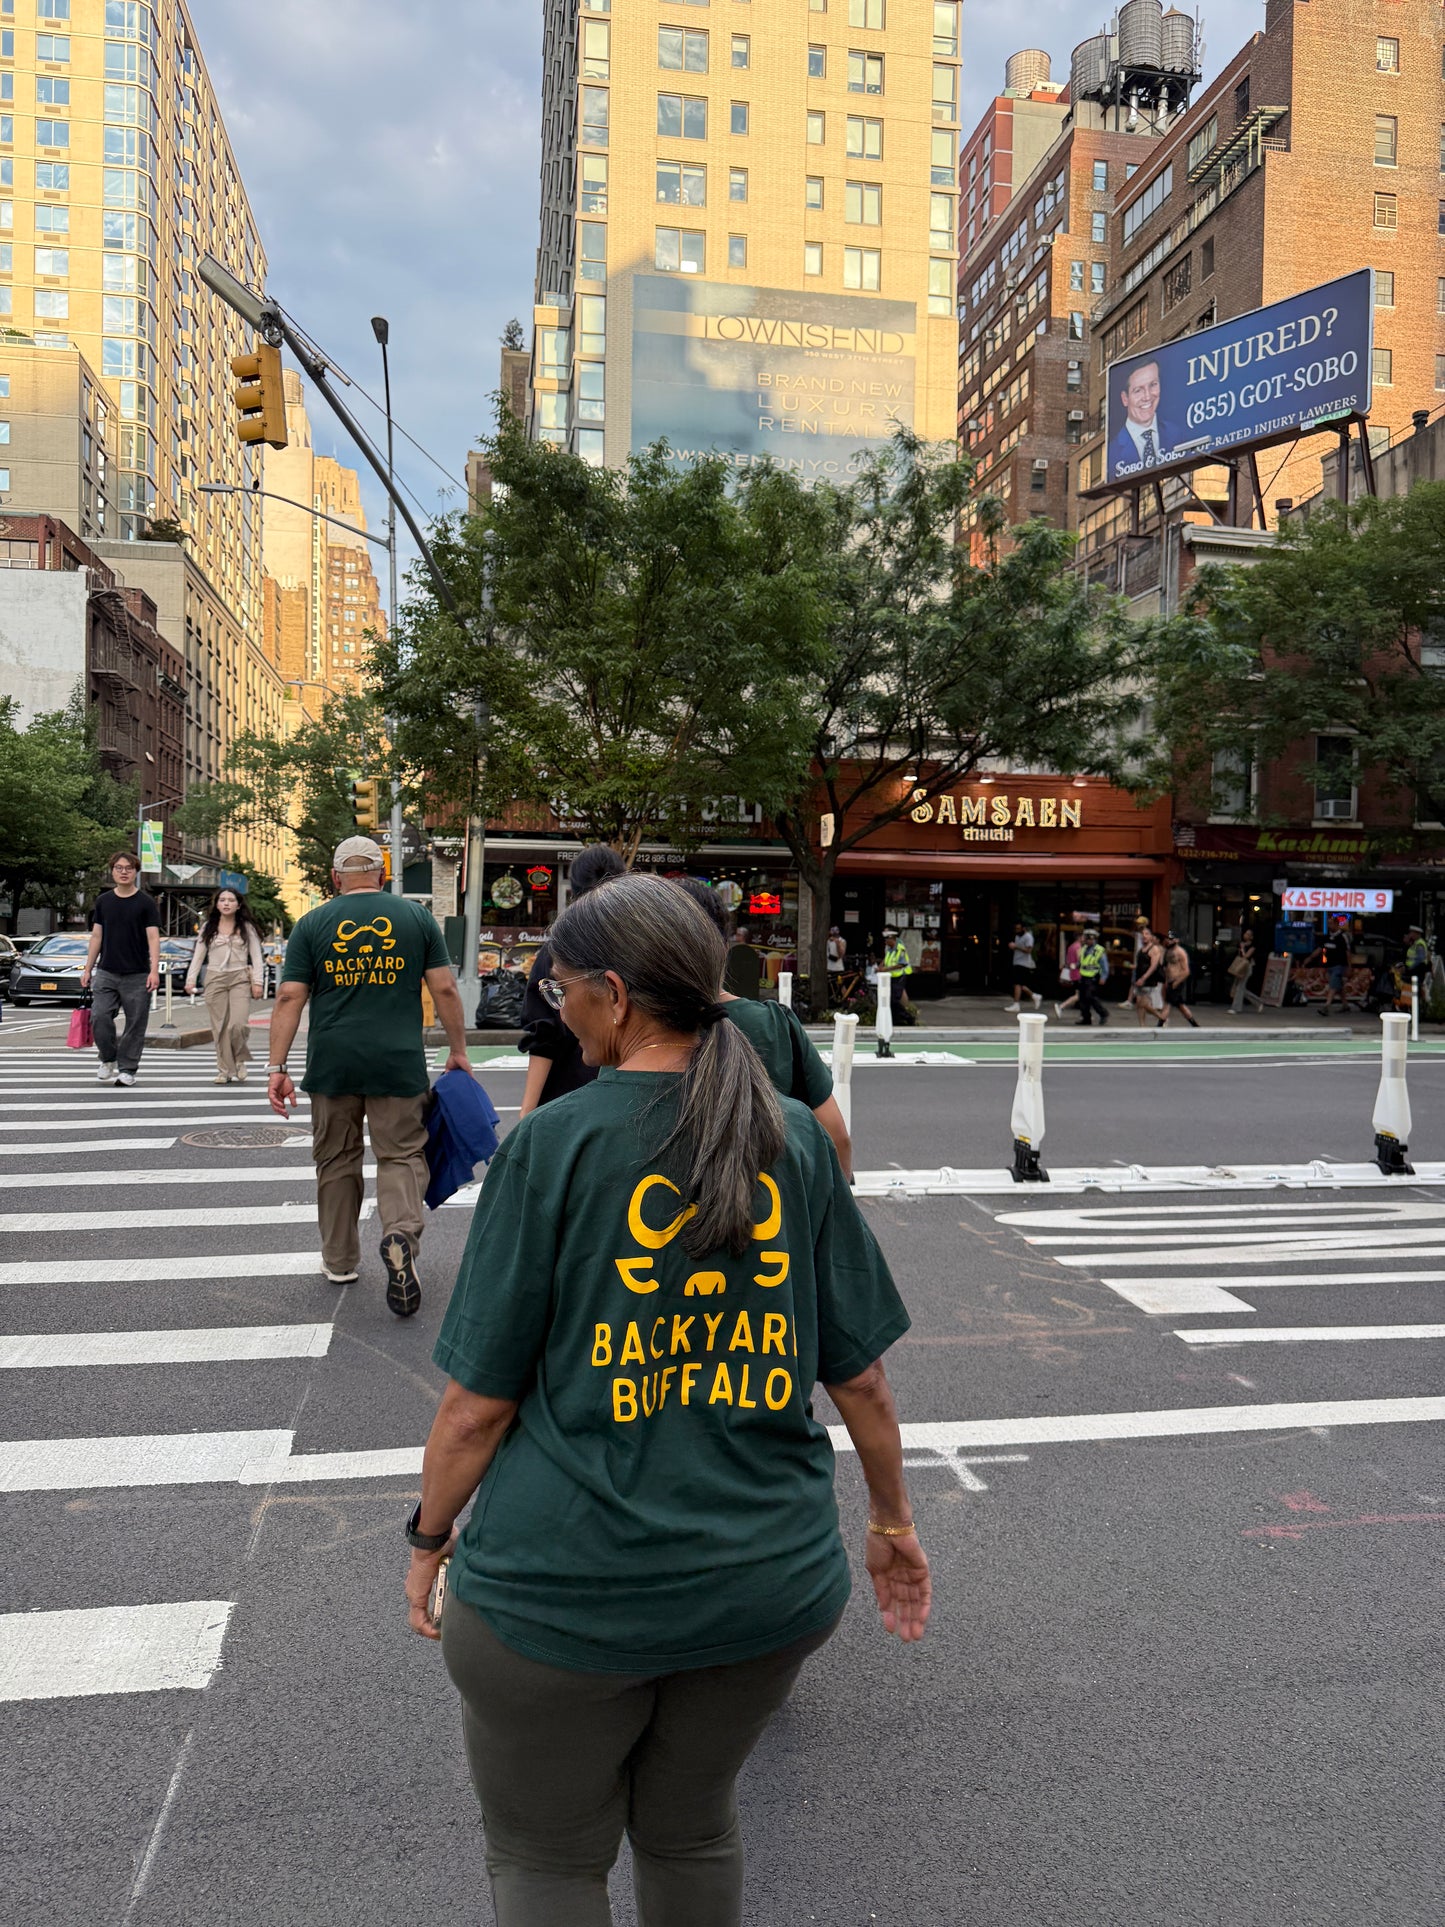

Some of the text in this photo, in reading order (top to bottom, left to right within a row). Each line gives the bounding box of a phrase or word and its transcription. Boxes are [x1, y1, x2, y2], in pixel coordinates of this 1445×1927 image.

[700, 315, 904, 355] TOWNSEND
[1186, 307, 1338, 386] INJURED?
[821, 352, 845, 360] WEST
[757, 372, 903, 397] BRAND NEW
[1186, 350, 1358, 428] (855) GOT-SOBO
[757, 394, 901, 419] LUXURY
[1254, 414, 1297, 435] INJURY
[1298, 395, 1358, 421] LAWYERS
[911, 788, 1083, 828] SAMSAEN
[1255, 832, 1374, 853] Kashmi
[636, 854, 650, 863] 212
[667, 854, 686, 863] 6204
[1281, 890, 1388, 909] KASHMIR 9
[325, 956, 405, 973] BACKYARD
[334, 971, 397, 986] BUFFALO
[591, 1310, 798, 1367] BACKYAR
[612, 1362, 793, 1423] BUFFALO
